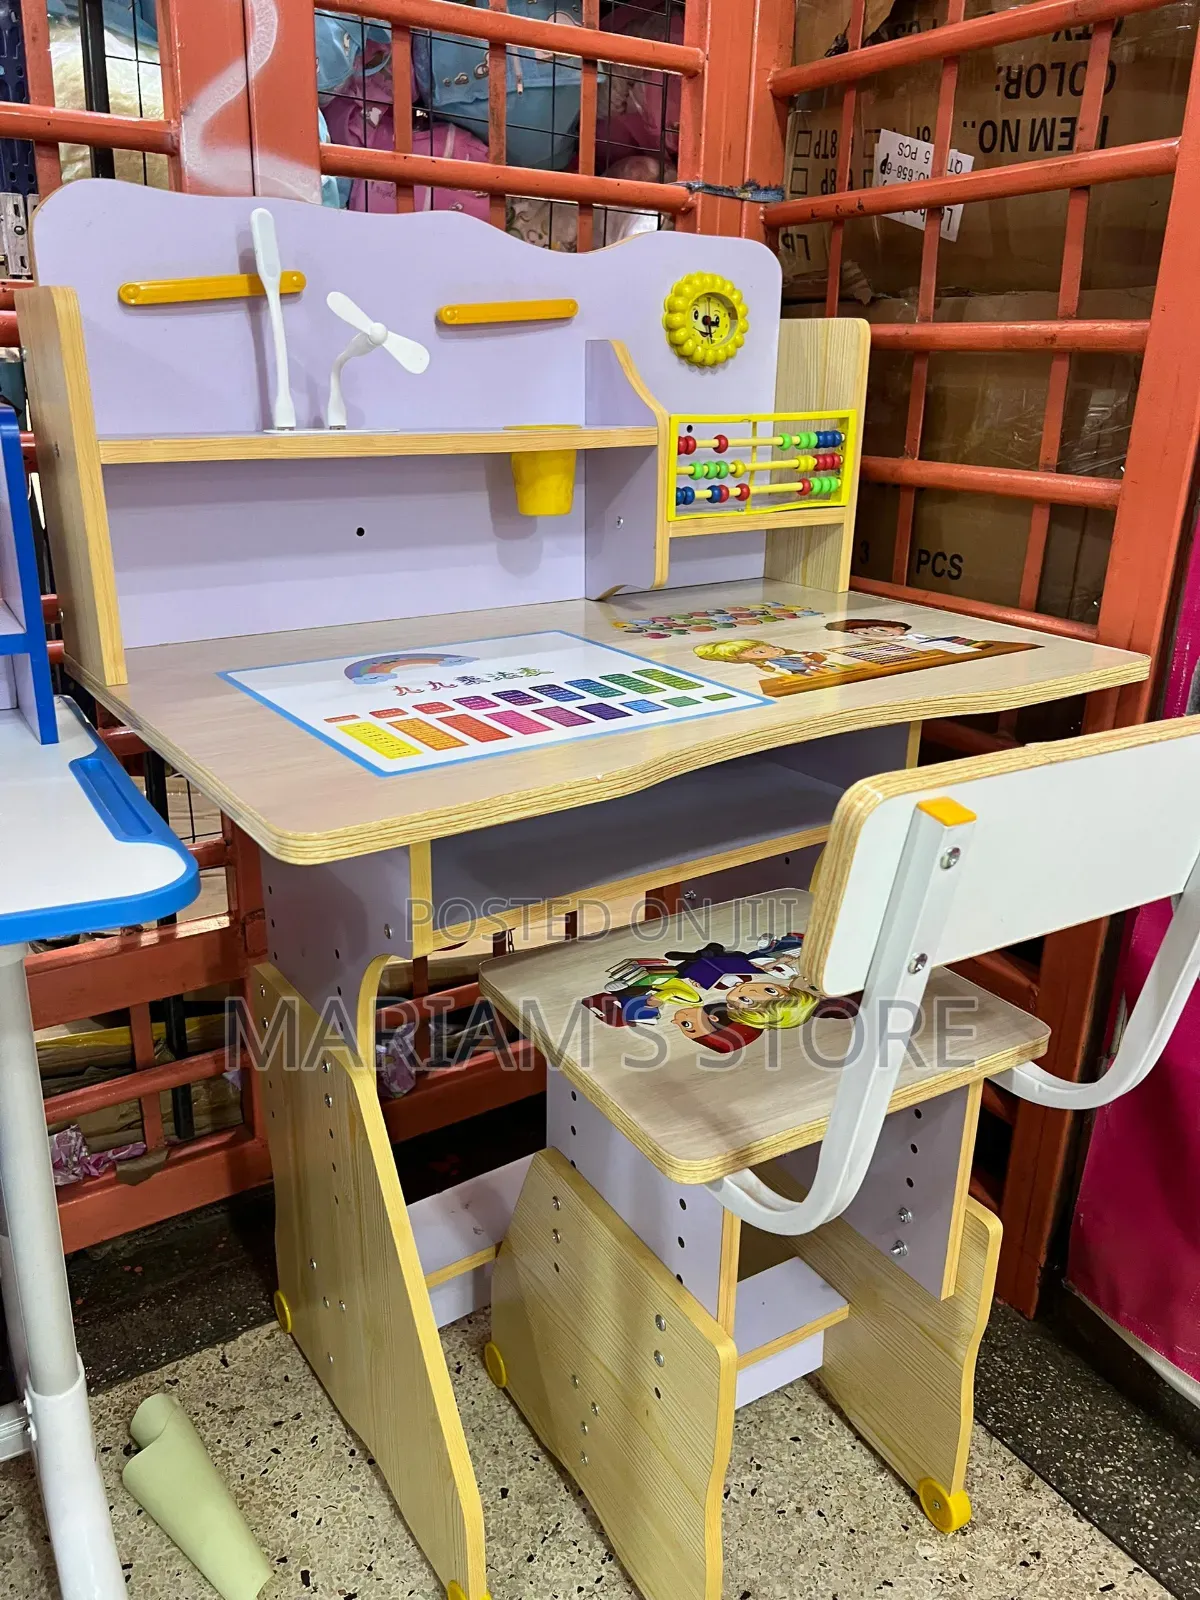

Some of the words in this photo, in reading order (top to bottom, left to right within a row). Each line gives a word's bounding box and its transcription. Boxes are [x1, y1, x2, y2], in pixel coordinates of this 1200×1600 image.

[1028, 116, 1109, 152] IEM
[898, 142, 918, 160] PCS
[915, 548, 964, 580] PCS
